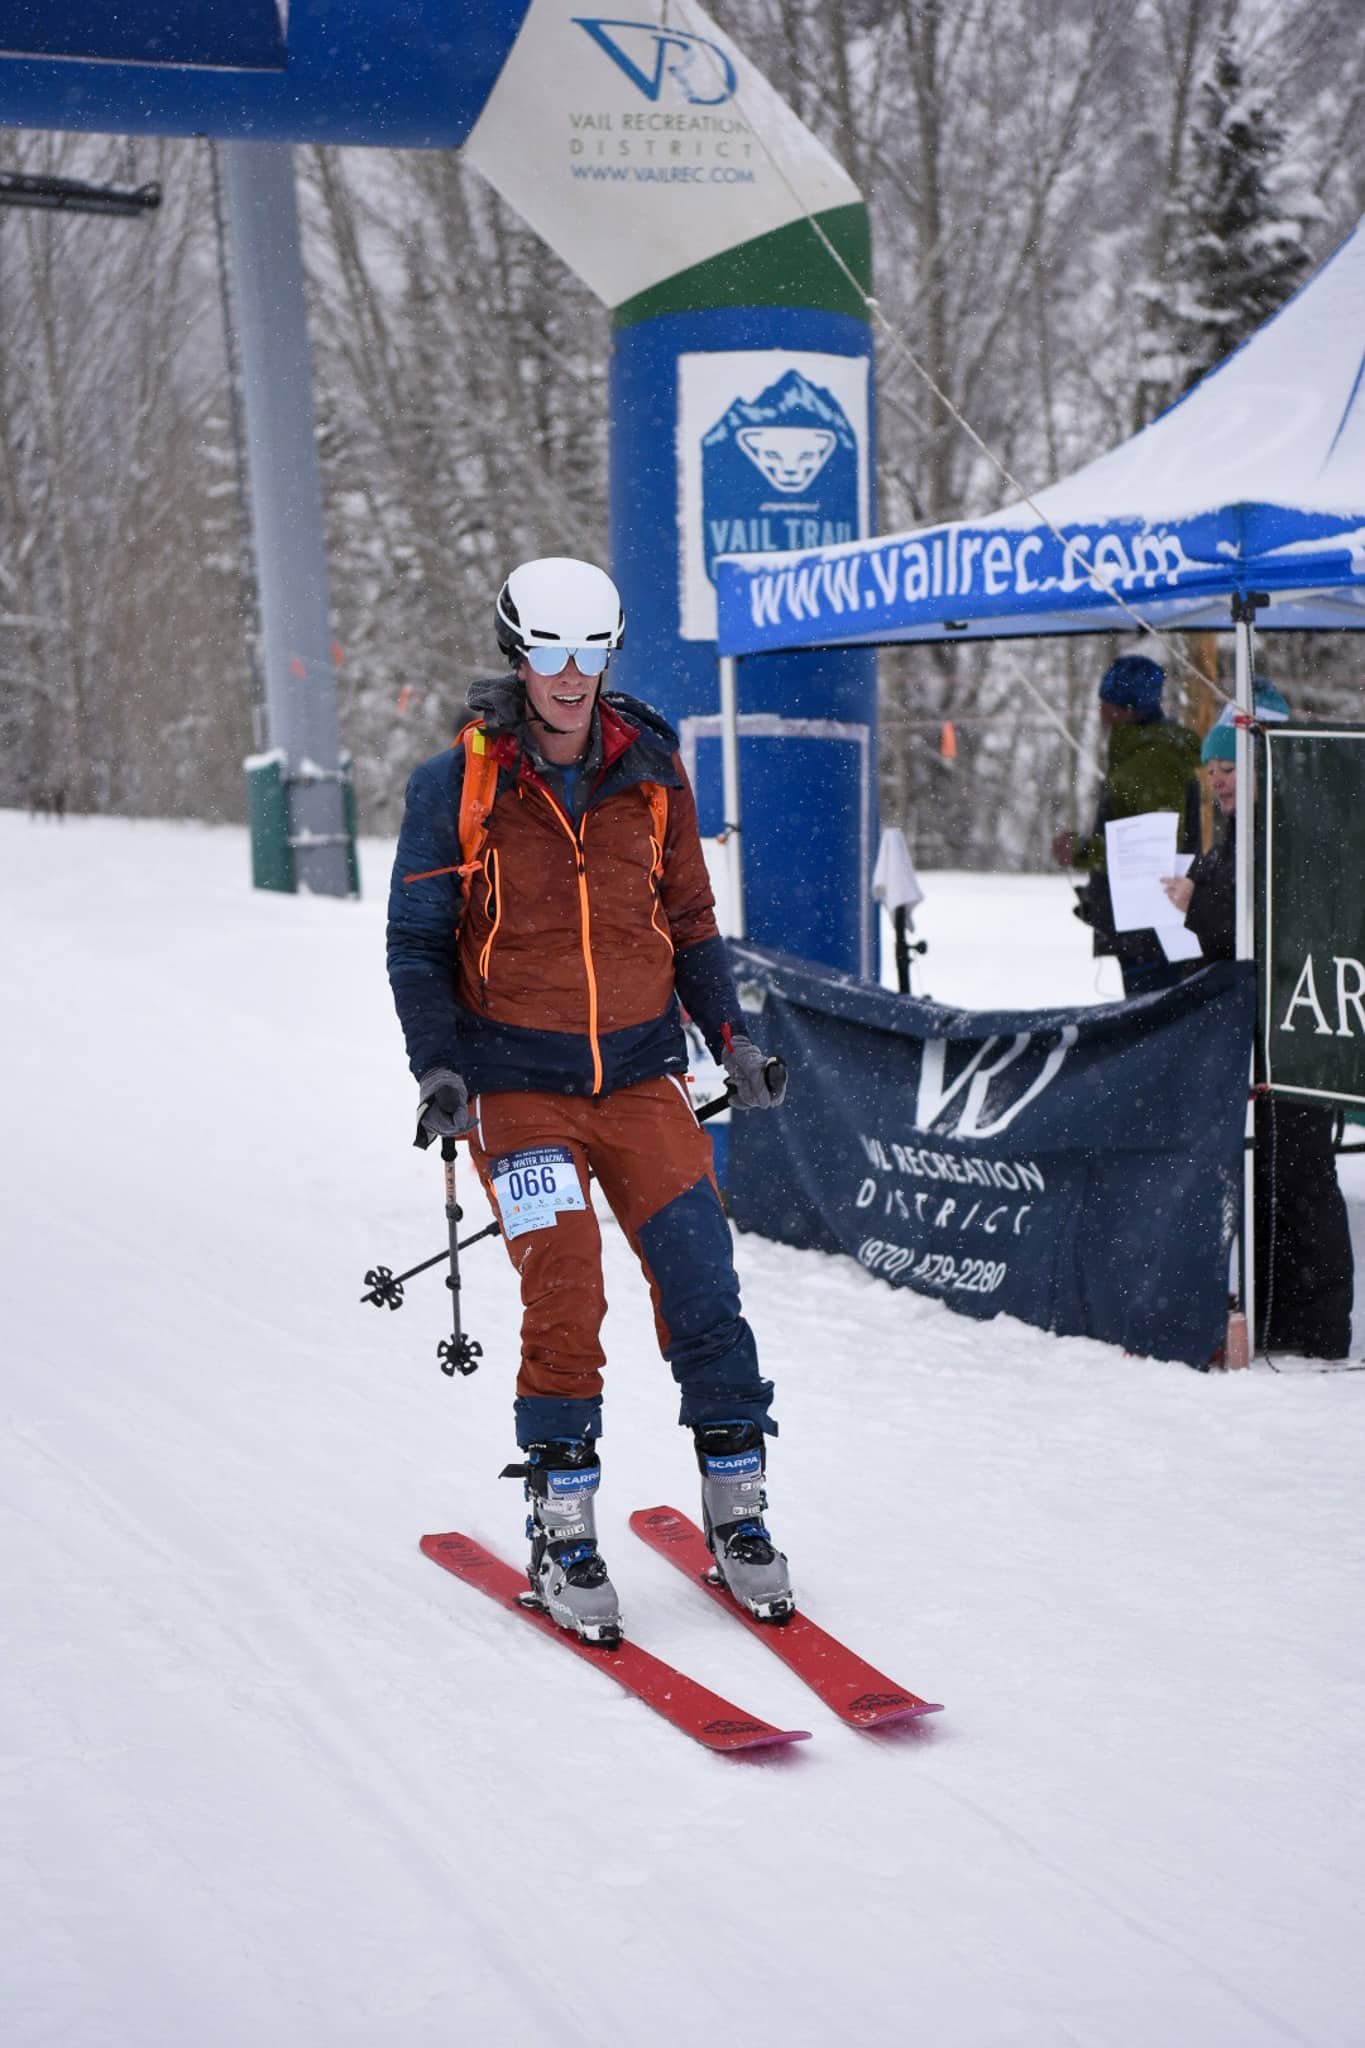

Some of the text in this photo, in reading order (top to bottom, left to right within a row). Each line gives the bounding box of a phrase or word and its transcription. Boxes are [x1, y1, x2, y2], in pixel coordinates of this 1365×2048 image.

[569, 113, 751, 134] VAIL RECREATION
[569, 138, 754, 158] DISTRICT
[710, 517, 778, 552] VAIL
[509, 1166, 557, 1201] 066
[892, 1143, 1045, 1193] RECREATION
[858, 1237, 915, 1278] (970)
[707, 1456, 759, 1470] SCARPA
